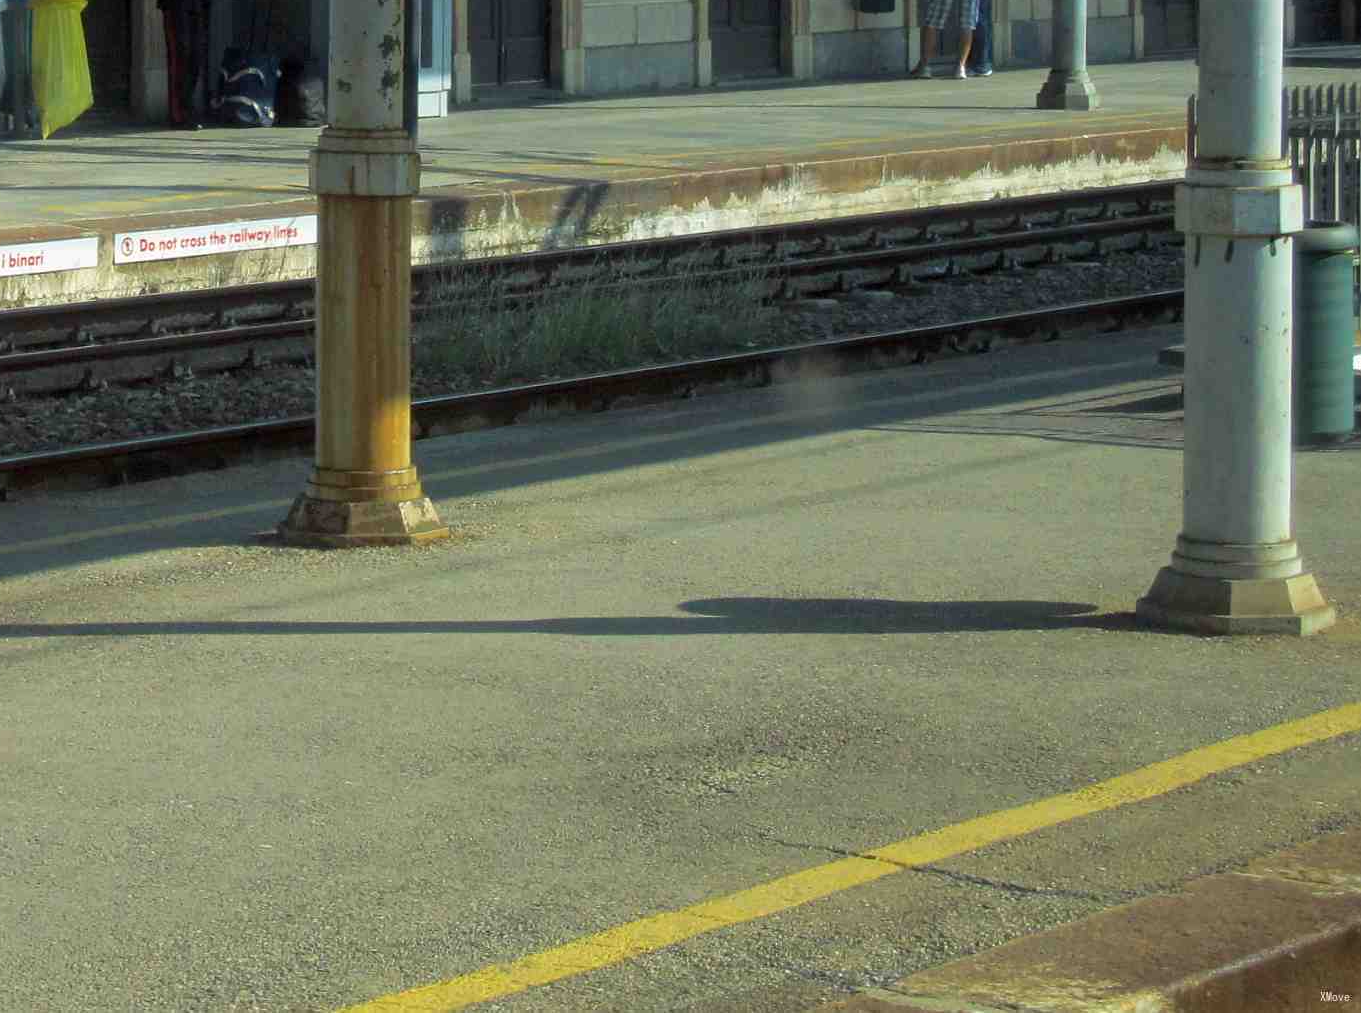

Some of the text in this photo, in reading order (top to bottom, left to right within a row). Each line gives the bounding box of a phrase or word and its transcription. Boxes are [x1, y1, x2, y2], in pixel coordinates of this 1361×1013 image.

[139, 225, 298, 252] Do not cross the railway lines
[1, 253, 6, 268] i
[9, 252, 45, 268] binari
